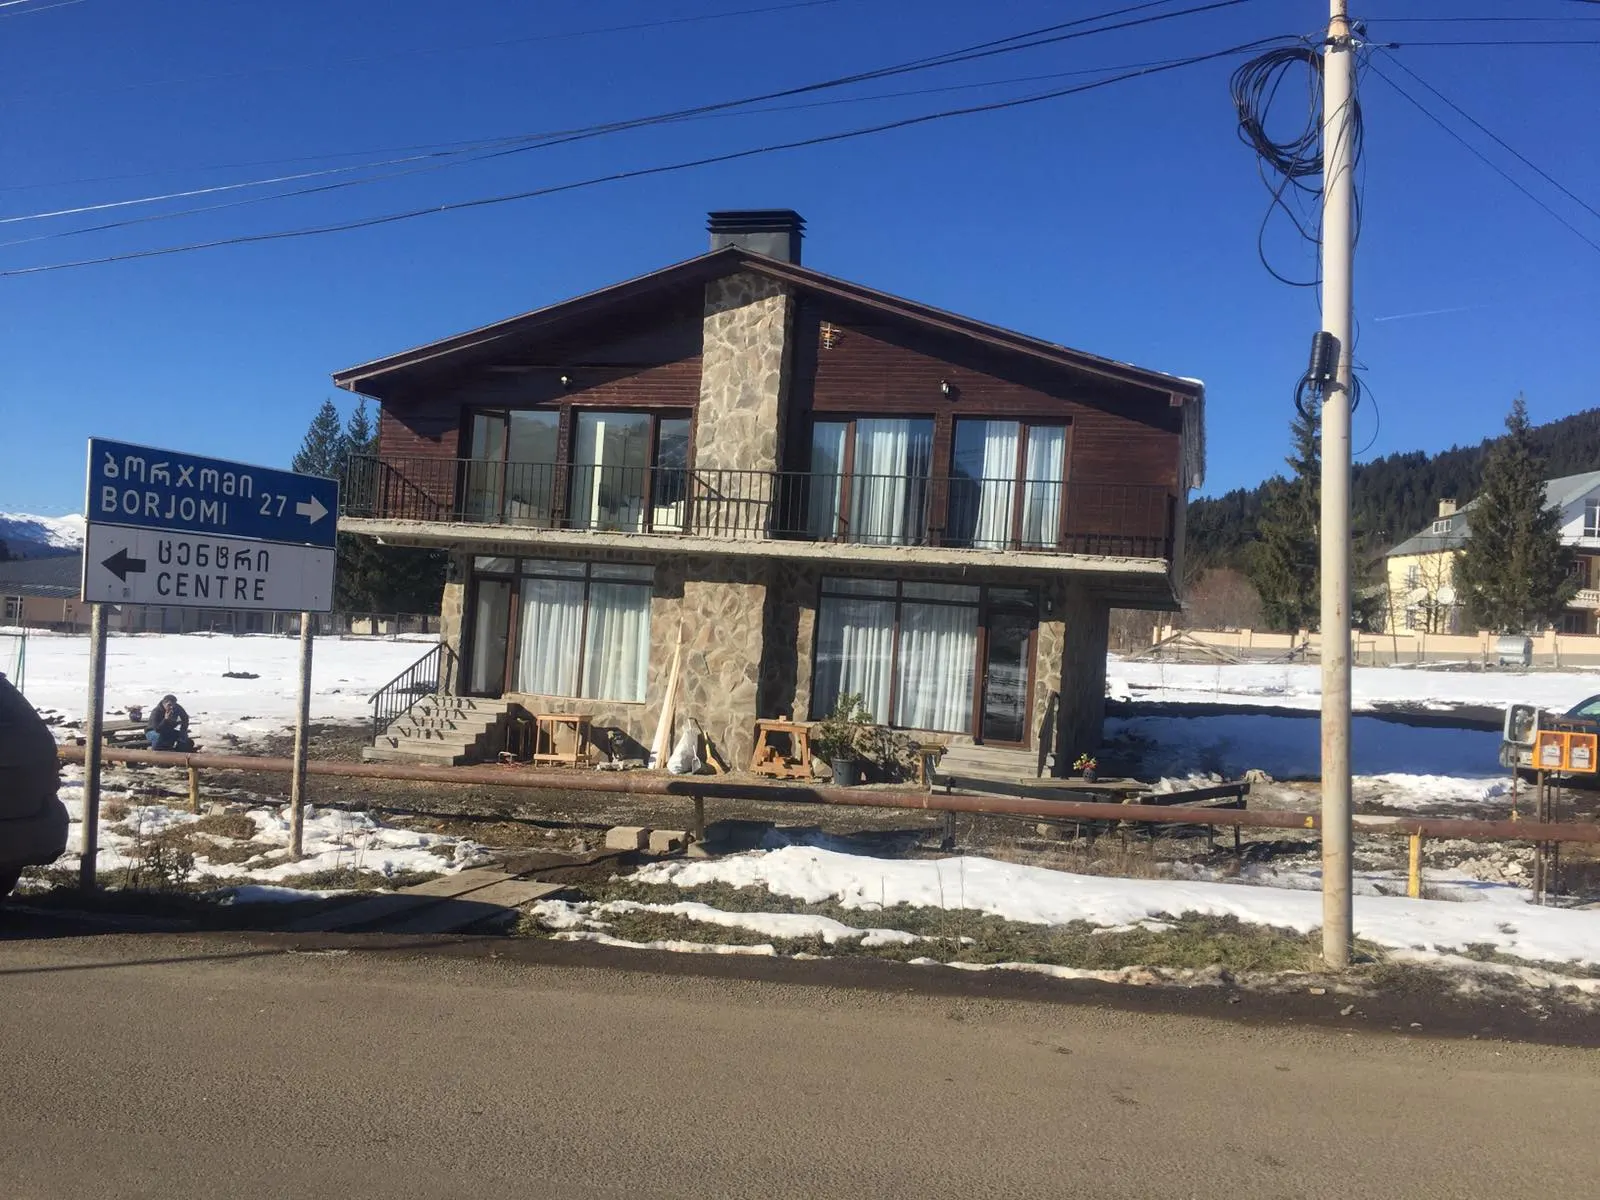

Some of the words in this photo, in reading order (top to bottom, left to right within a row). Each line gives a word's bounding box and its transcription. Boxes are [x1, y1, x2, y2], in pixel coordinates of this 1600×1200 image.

[103, 452, 253, 498] ბორჯომი
[101, 486, 227, 525] BORJOMI
[259, 492, 287, 518] 27
[158, 540, 269, 572] ცენტრი
[156, 572, 266, 601] CENTRE
